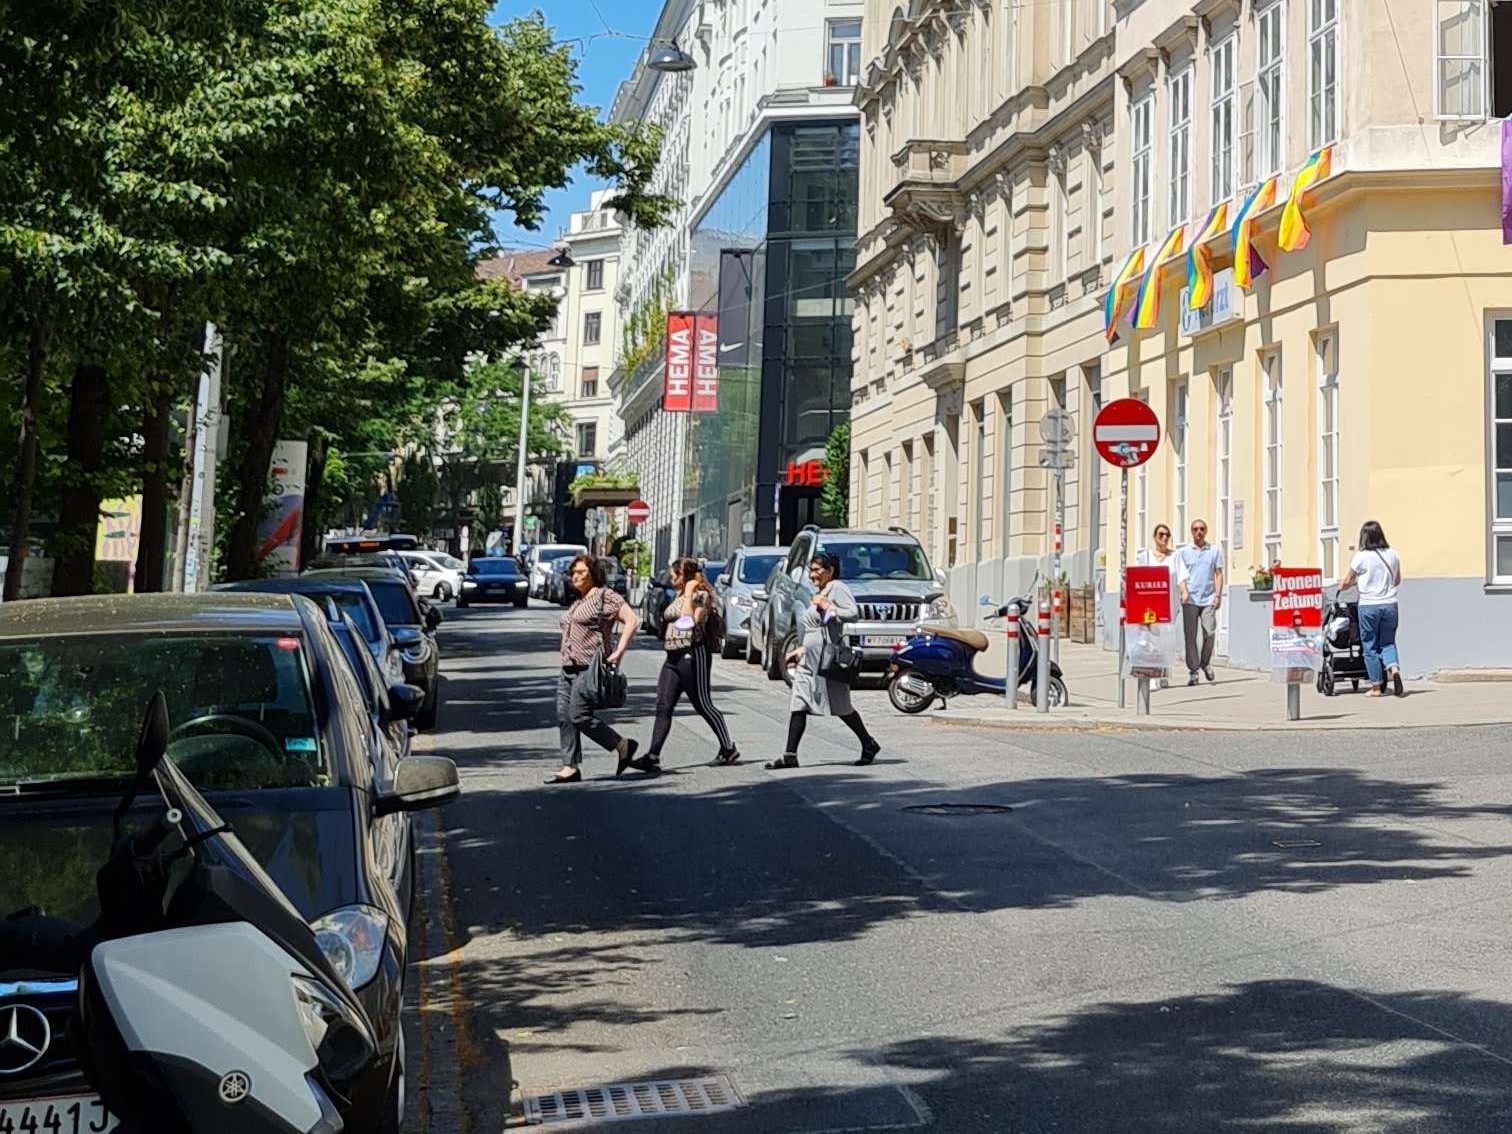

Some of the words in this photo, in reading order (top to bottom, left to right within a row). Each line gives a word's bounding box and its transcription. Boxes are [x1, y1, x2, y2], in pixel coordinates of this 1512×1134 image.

[668, 329, 690, 396] HEMA
[786, 461, 831, 485] HE
[1134, 581, 1168, 589] KURIER
[1273, 574, 1322, 592] Kronen
[1273, 592, 1323, 610] Zeitung
